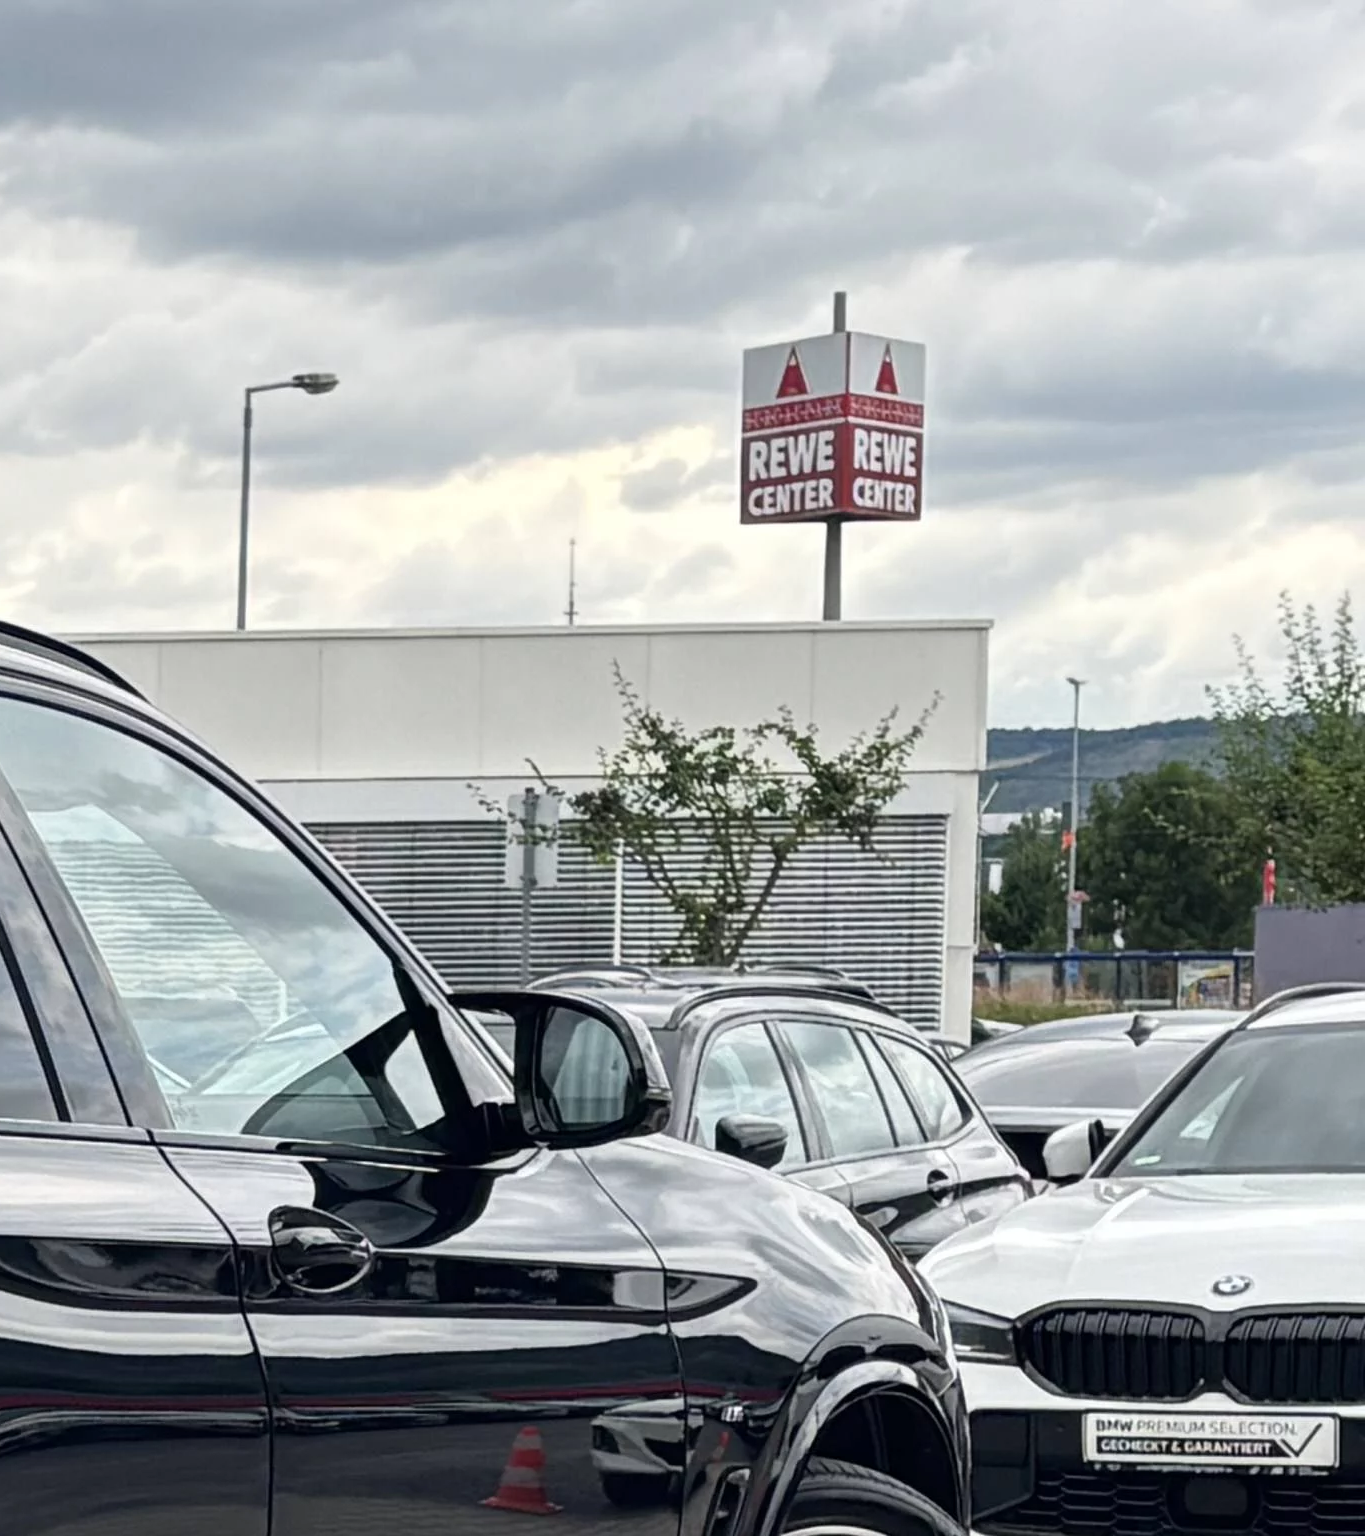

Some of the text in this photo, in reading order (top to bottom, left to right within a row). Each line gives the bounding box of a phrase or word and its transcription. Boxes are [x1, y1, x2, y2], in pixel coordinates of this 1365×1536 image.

[749, 430, 835, 481] REWE
[853, 428, 917, 477] REWE
[747, 478, 834, 516] CENTER
[852, 476, 916, 514] CENTER
[1096, 1419, 1133, 1432] BMW
[1137, 1420, 1205, 1433] PREMIUM
[1184, 1440, 1271, 1454] GARANTIERT
